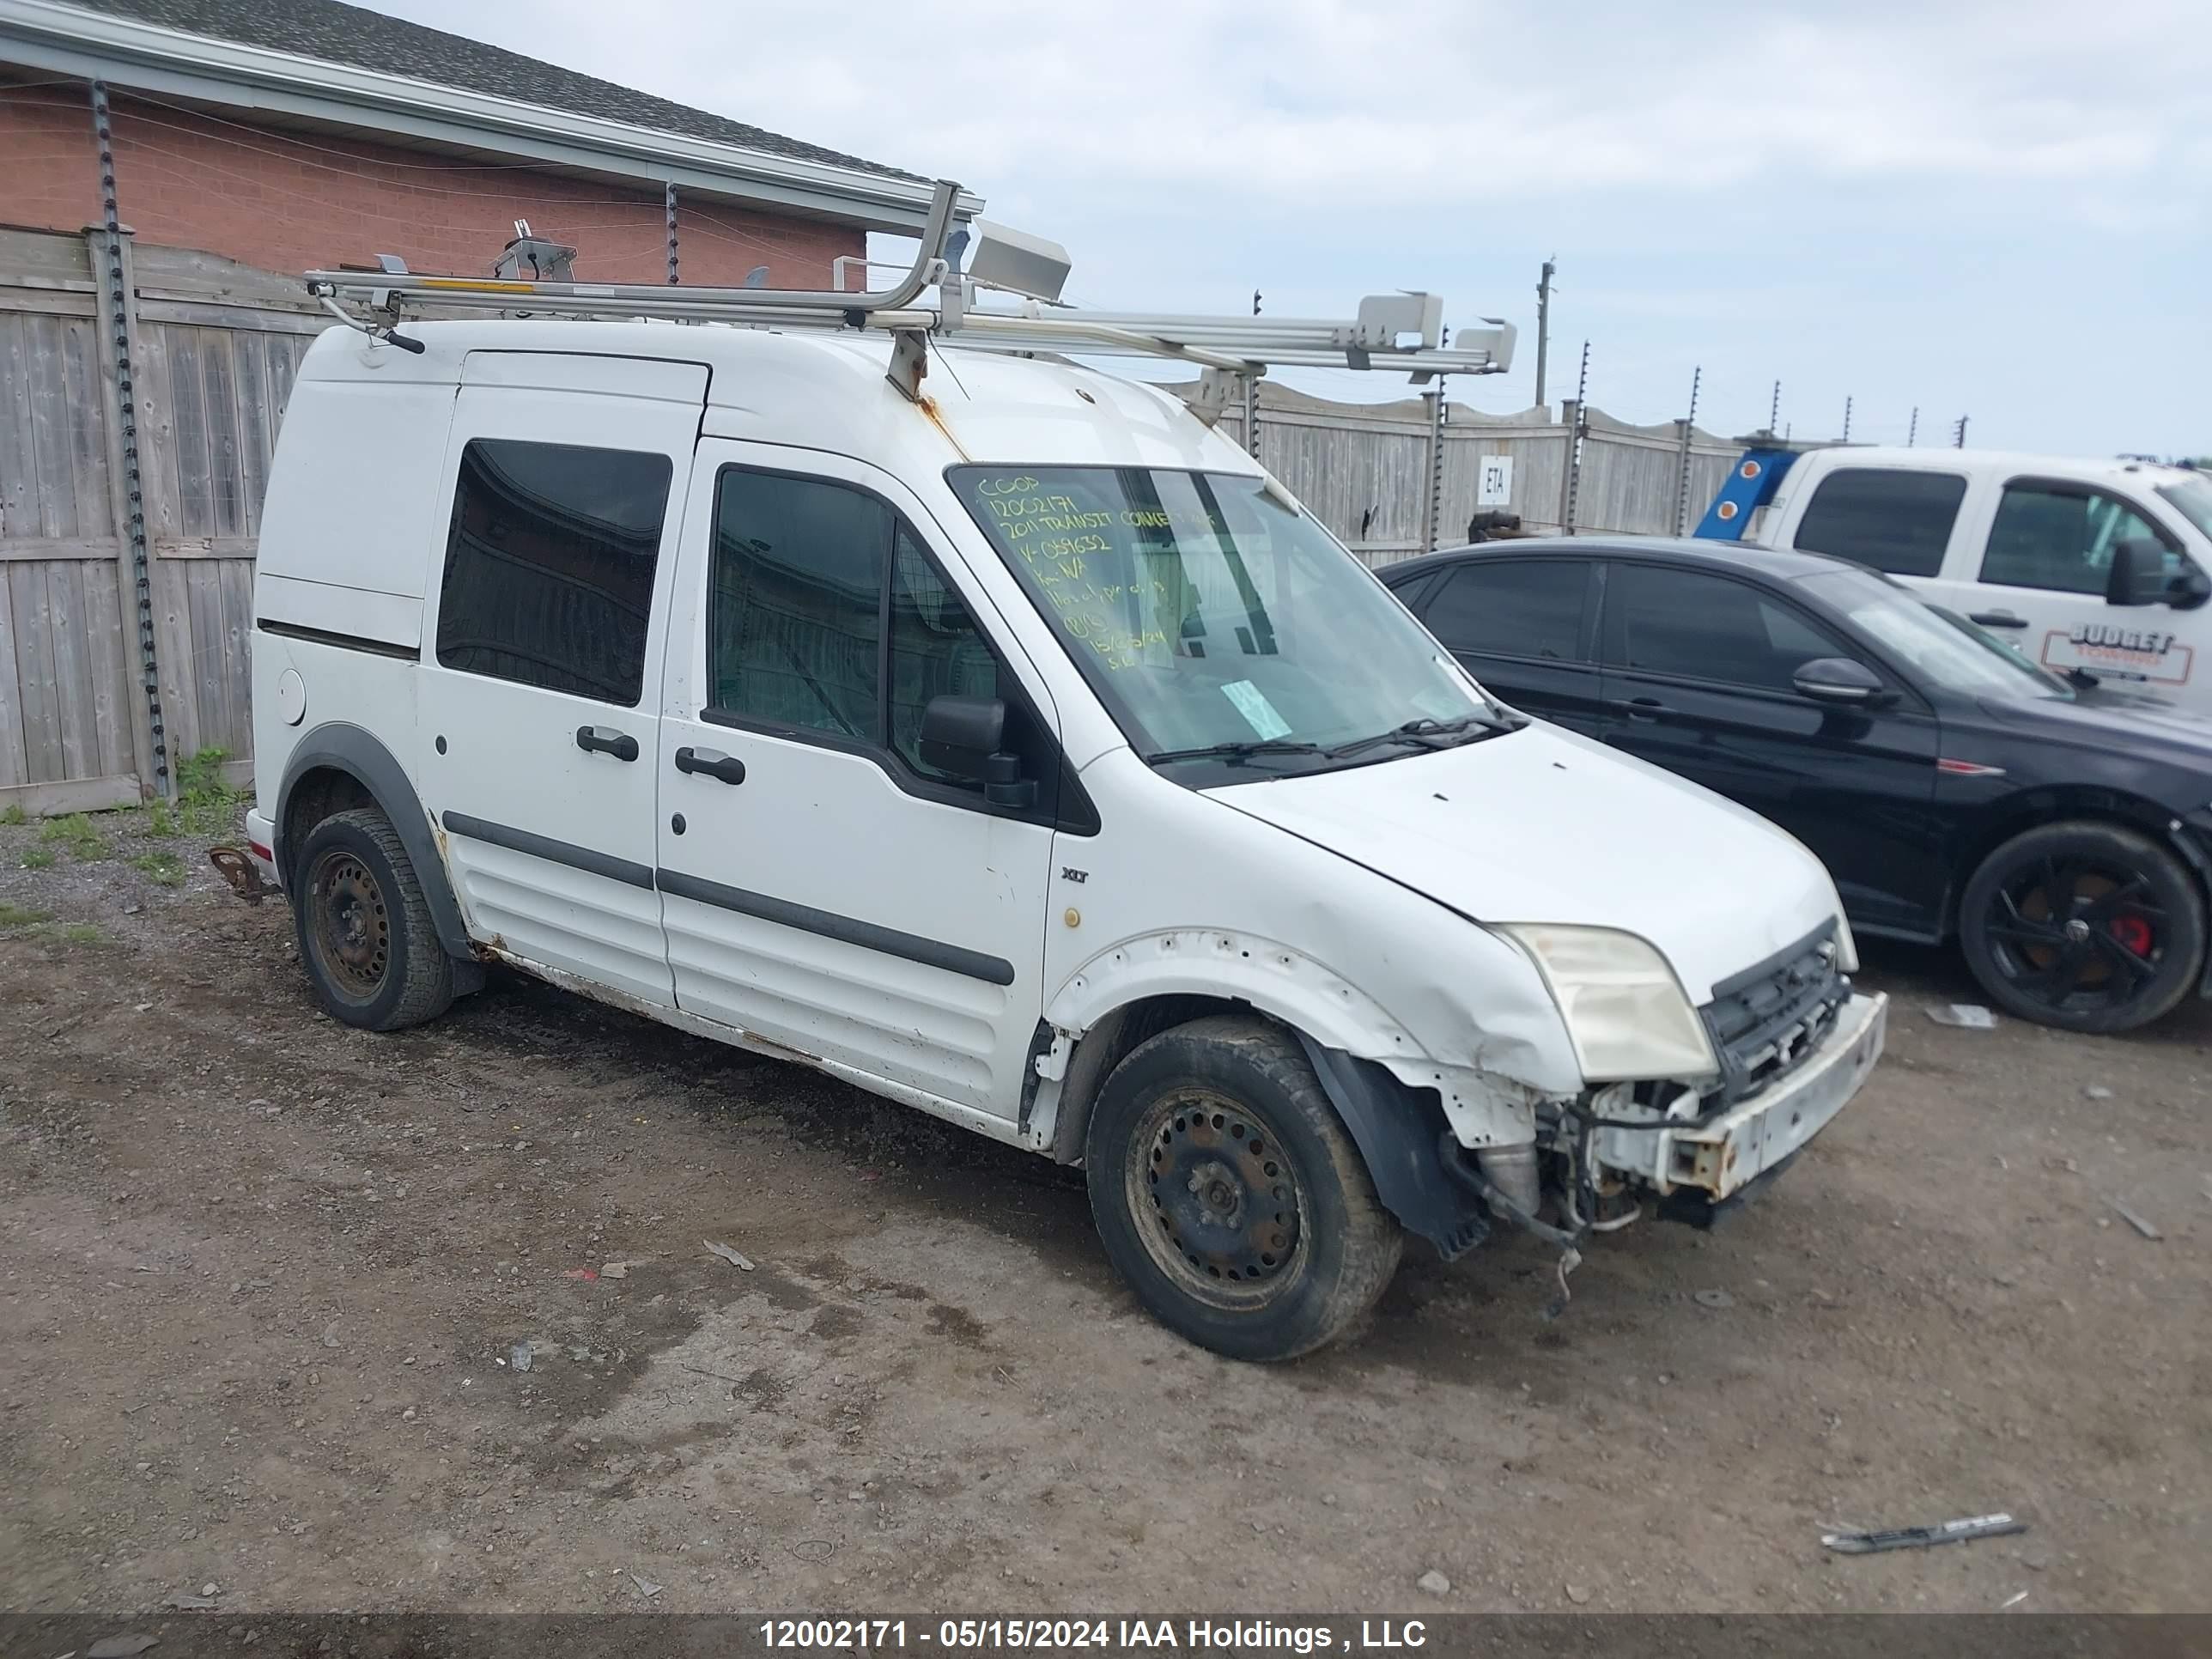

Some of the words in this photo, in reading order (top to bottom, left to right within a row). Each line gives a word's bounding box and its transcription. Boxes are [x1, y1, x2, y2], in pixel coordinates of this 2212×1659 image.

[1486, 467, 1504, 494] ETA
[1000, 519, 1040, 539] 2011
[1039, 513, 1113, 532] TRANSIT
[2070, 623, 2176, 655] BUDGET
[1061, 866, 1089, 884] XLT
